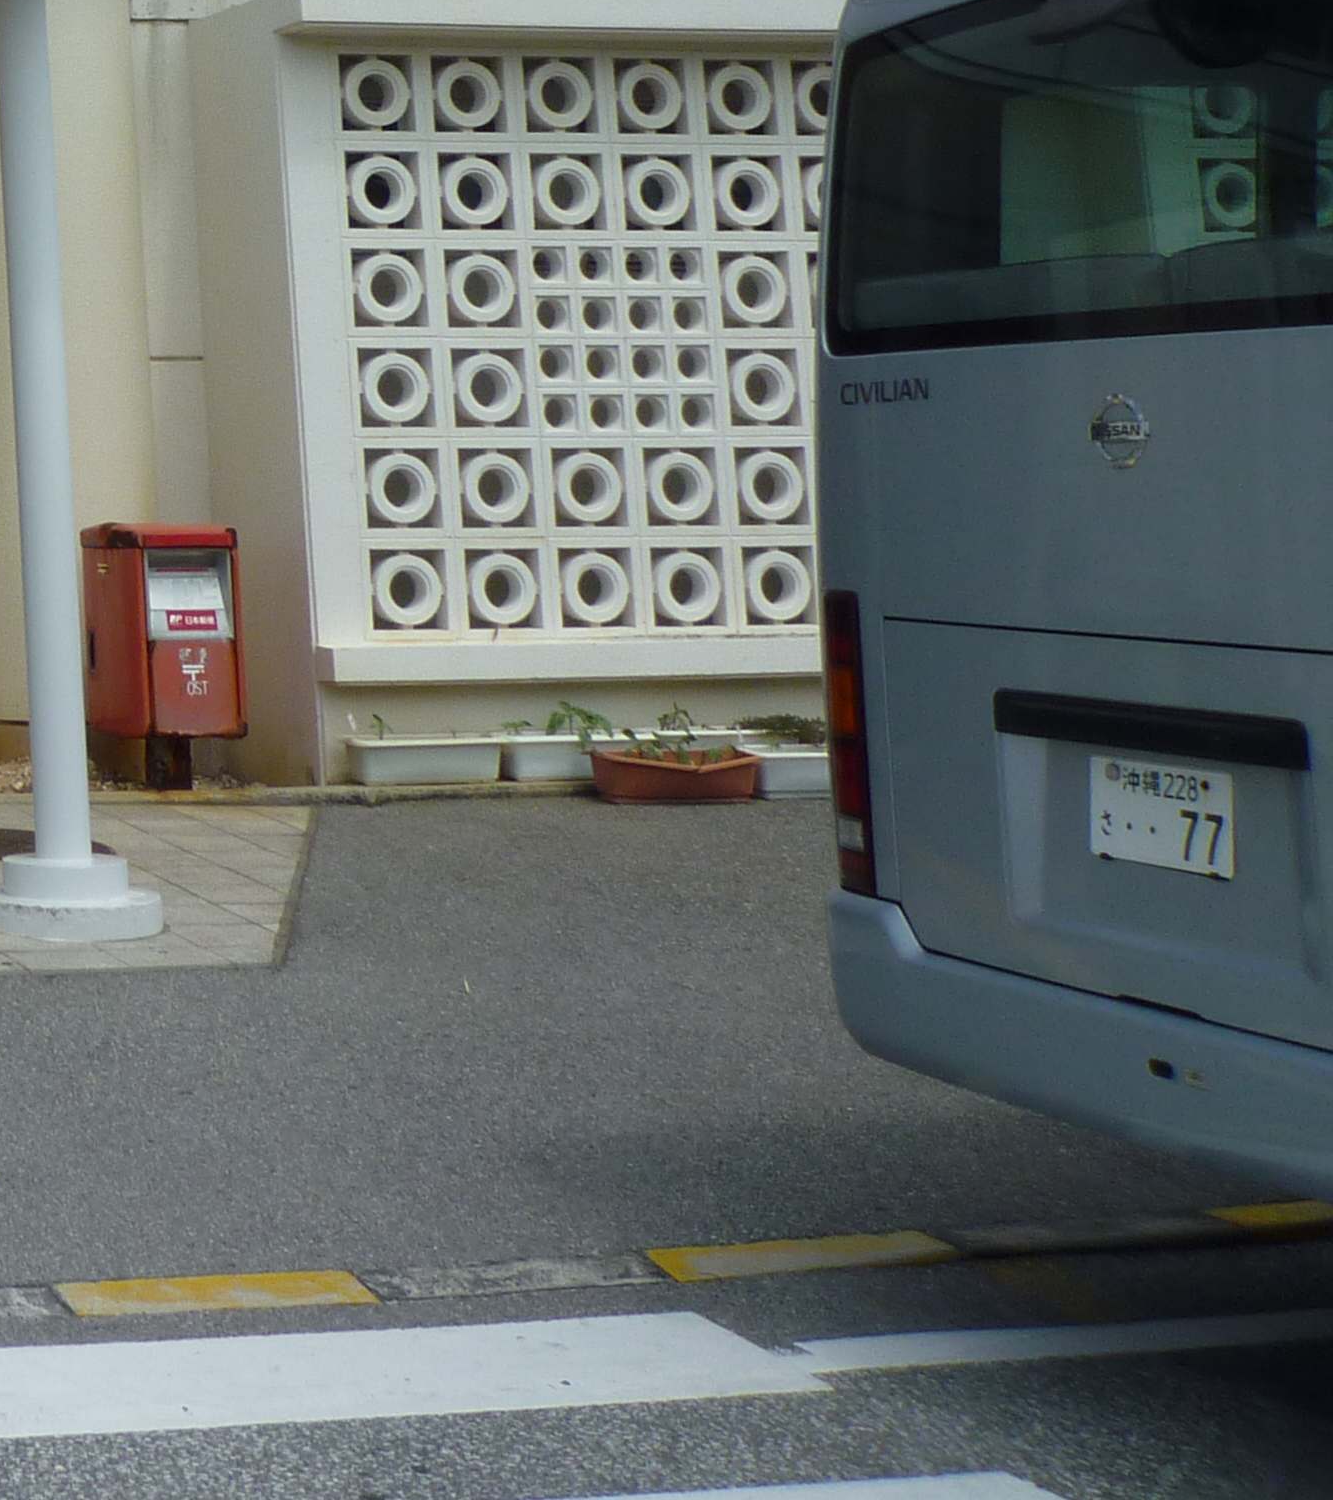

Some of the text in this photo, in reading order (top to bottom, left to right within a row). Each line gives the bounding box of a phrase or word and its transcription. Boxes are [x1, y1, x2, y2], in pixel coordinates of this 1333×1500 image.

[840, 378, 929, 405] CIVILIAN
[1100, 808, 1224, 866] さ 77
